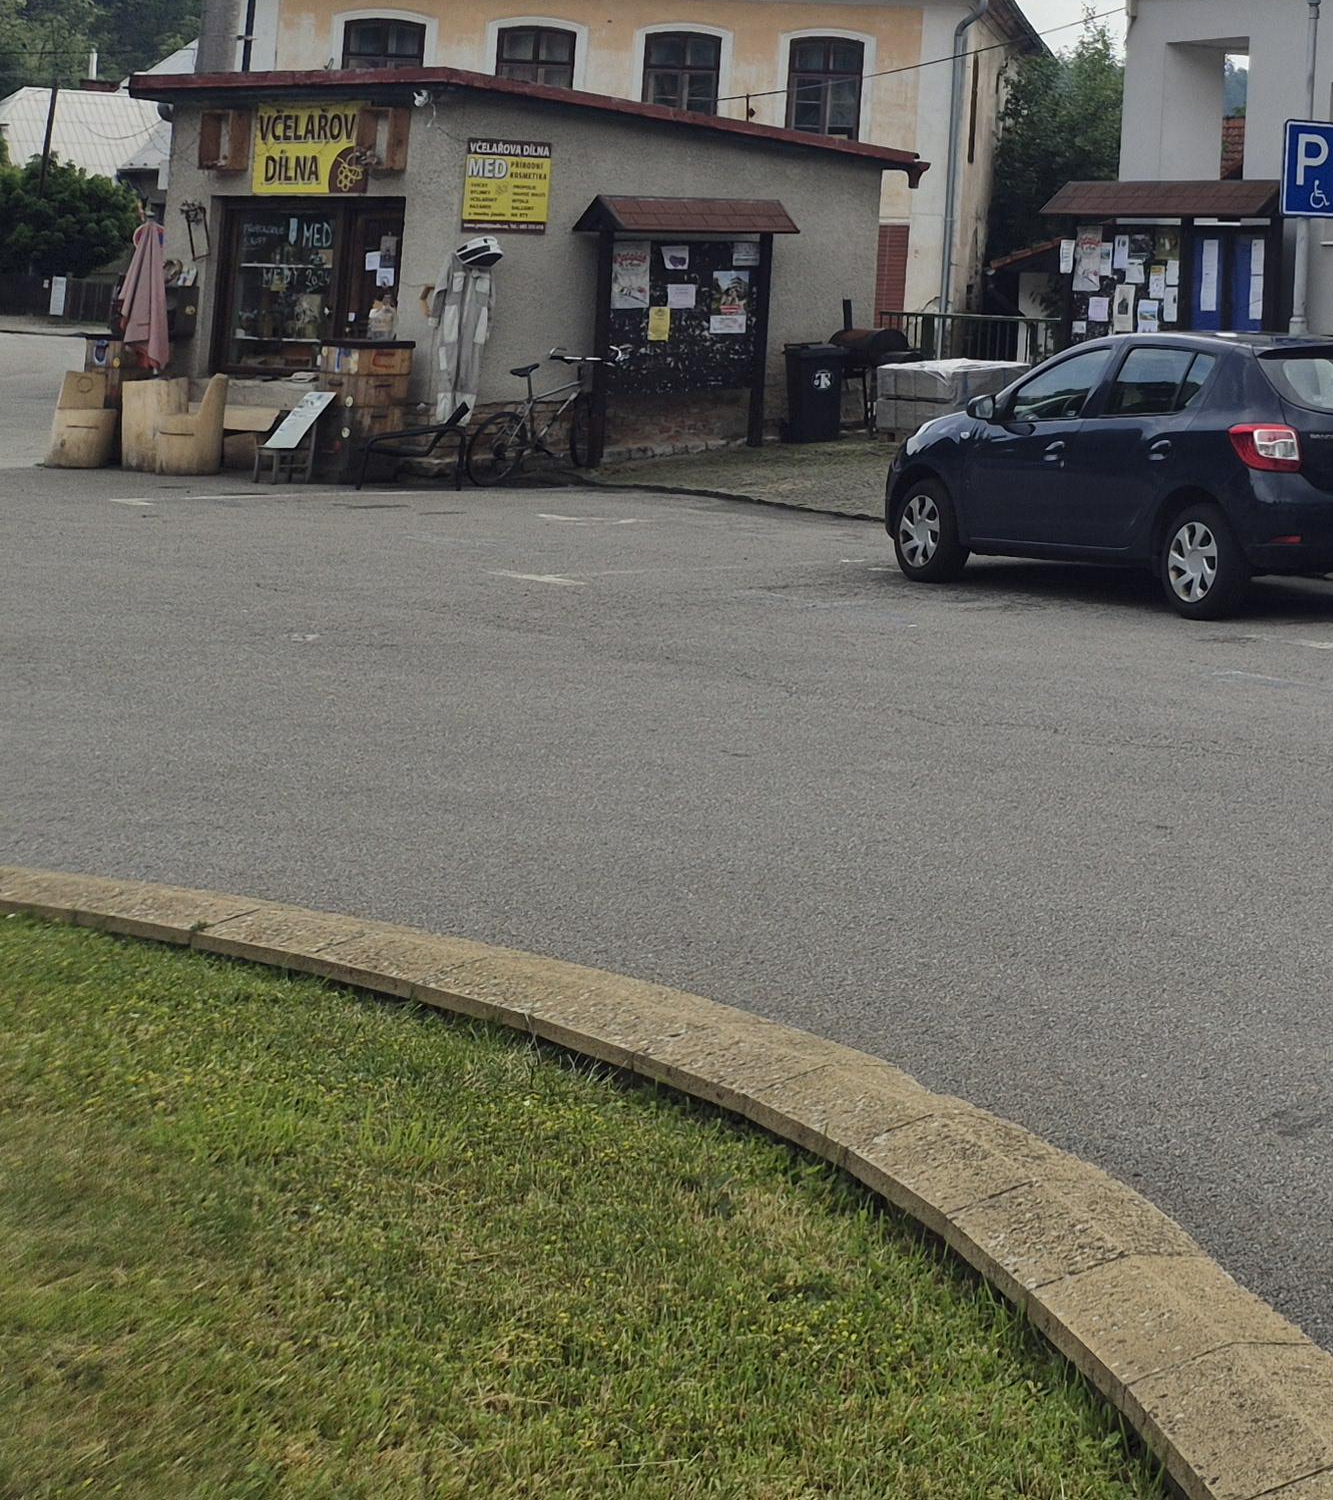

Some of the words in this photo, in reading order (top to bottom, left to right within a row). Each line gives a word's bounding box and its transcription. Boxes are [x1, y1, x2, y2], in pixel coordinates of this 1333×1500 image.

[260, 107, 357, 142] VČELAŘOV
[470, 141, 522, 155] VČELAŘOVA
[523, 144, 550, 157] DÍLNA
[1296, 133, 1329, 185] P
[264, 149, 320, 182] DÍLNA
[468, 157, 508, 179] MED
[510, 172, 547, 180] KOSMETIKA
[302, 221, 332, 248] MED
